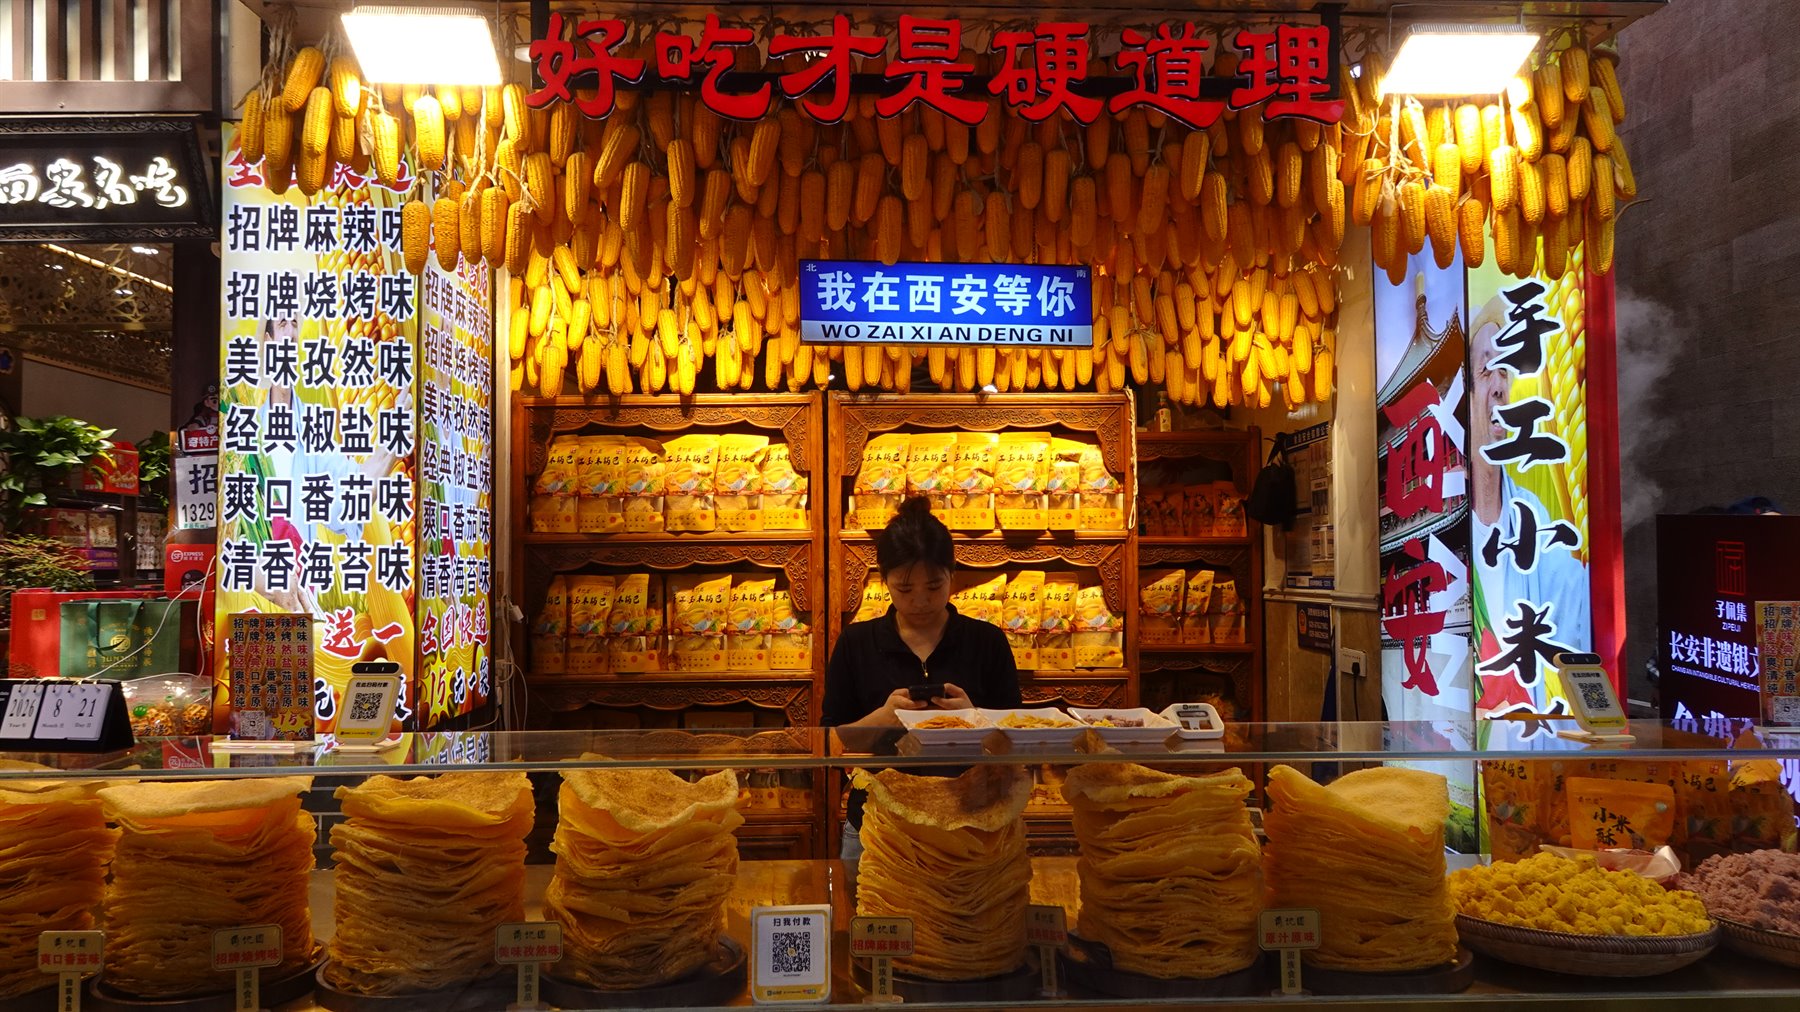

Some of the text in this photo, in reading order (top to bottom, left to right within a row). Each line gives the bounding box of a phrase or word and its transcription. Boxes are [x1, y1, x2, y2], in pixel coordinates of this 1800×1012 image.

[526, 13, 1345, 127] 好吃才是硬道理
[229, 204, 404, 252] 招牌麻辣味
[805, 263, 817, 272] 北
[1076, 269, 1087, 278] 南
[227, 272, 414, 320] 招牌烧烤味
[425, 267, 491, 345] 招牌麻辣味
[817, 270, 1076, 317] 我在西安等你
[821, 323, 861, 340] WO
[867, 324, 904, 340] ZAI
[978, 327, 1042, 342] DENG
[1050, 328, 1074, 342] NI
[227, 338, 414, 387] 美味孜然味
[424, 324, 491, 394] 招牌烧烤味
[225, 406, 412, 455] 经典椒盐味
[423, 381, 491, 445] 美味孜然味
[422, 441, 491, 493] 经典椒盐味
[224, 475, 412, 523] 爽口番茄味
[422, 498, 490, 544] 爽口番茄味
[1383, 381, 1448, 697] 西安
[222, 543, 411, 592] 清香海苔味
[421, 556, 490, 598] 清香海苔味
[422, 601, 488, 653] 全国快递
[1716, 600, 1747, 622] 子佩集
[9, 699, 36, 717] 2026
[53, 699, 62, 717] 8
[78, 698, 97, 717] 21
[773, 917, 811, 926] 扫我付款
[1265, 932, 1315, 944] 原汁原味
